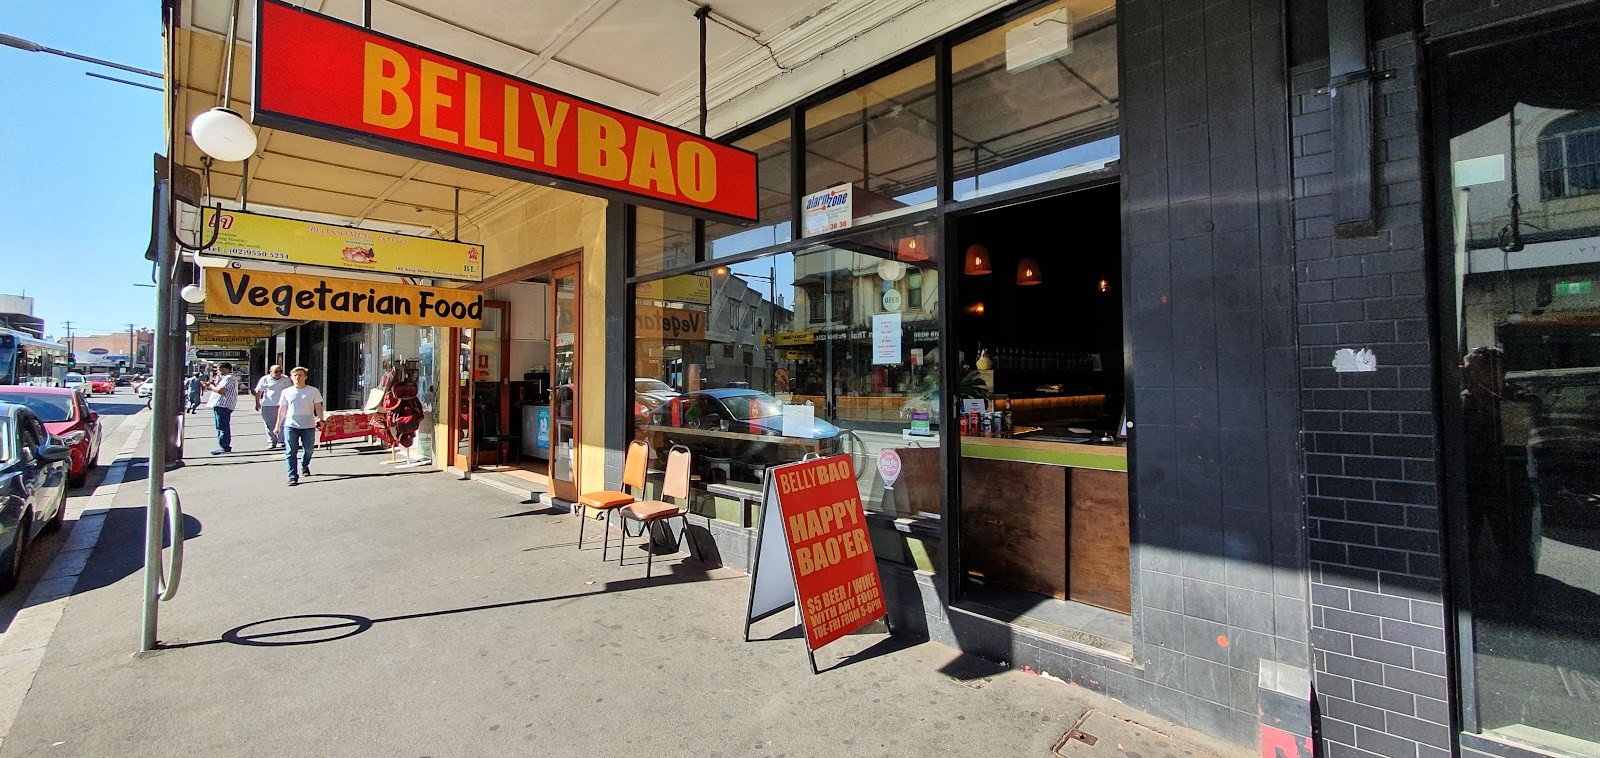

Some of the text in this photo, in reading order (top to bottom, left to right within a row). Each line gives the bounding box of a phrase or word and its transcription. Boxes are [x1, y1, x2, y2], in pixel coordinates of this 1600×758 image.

[229, 248, 267, 258] (02)9550
[269, 252, 289, 260] 5234
[222, 271, 483, 321] Vegetarian Food
[884, 296, 900, 304] OPEN
[788, 497, 859, 544] HAPPY
[796, 528, 869, 577] BAO'ER
[806, 595, 823, 616] $5
[822, 584, 847, 608] BEER
[852, 571, 877, 595] WINE
[809, 586, 880, 628] WITH ANY FOOD
[812, 598, 882, 641] TUE-FRI FROM 5-6PM
